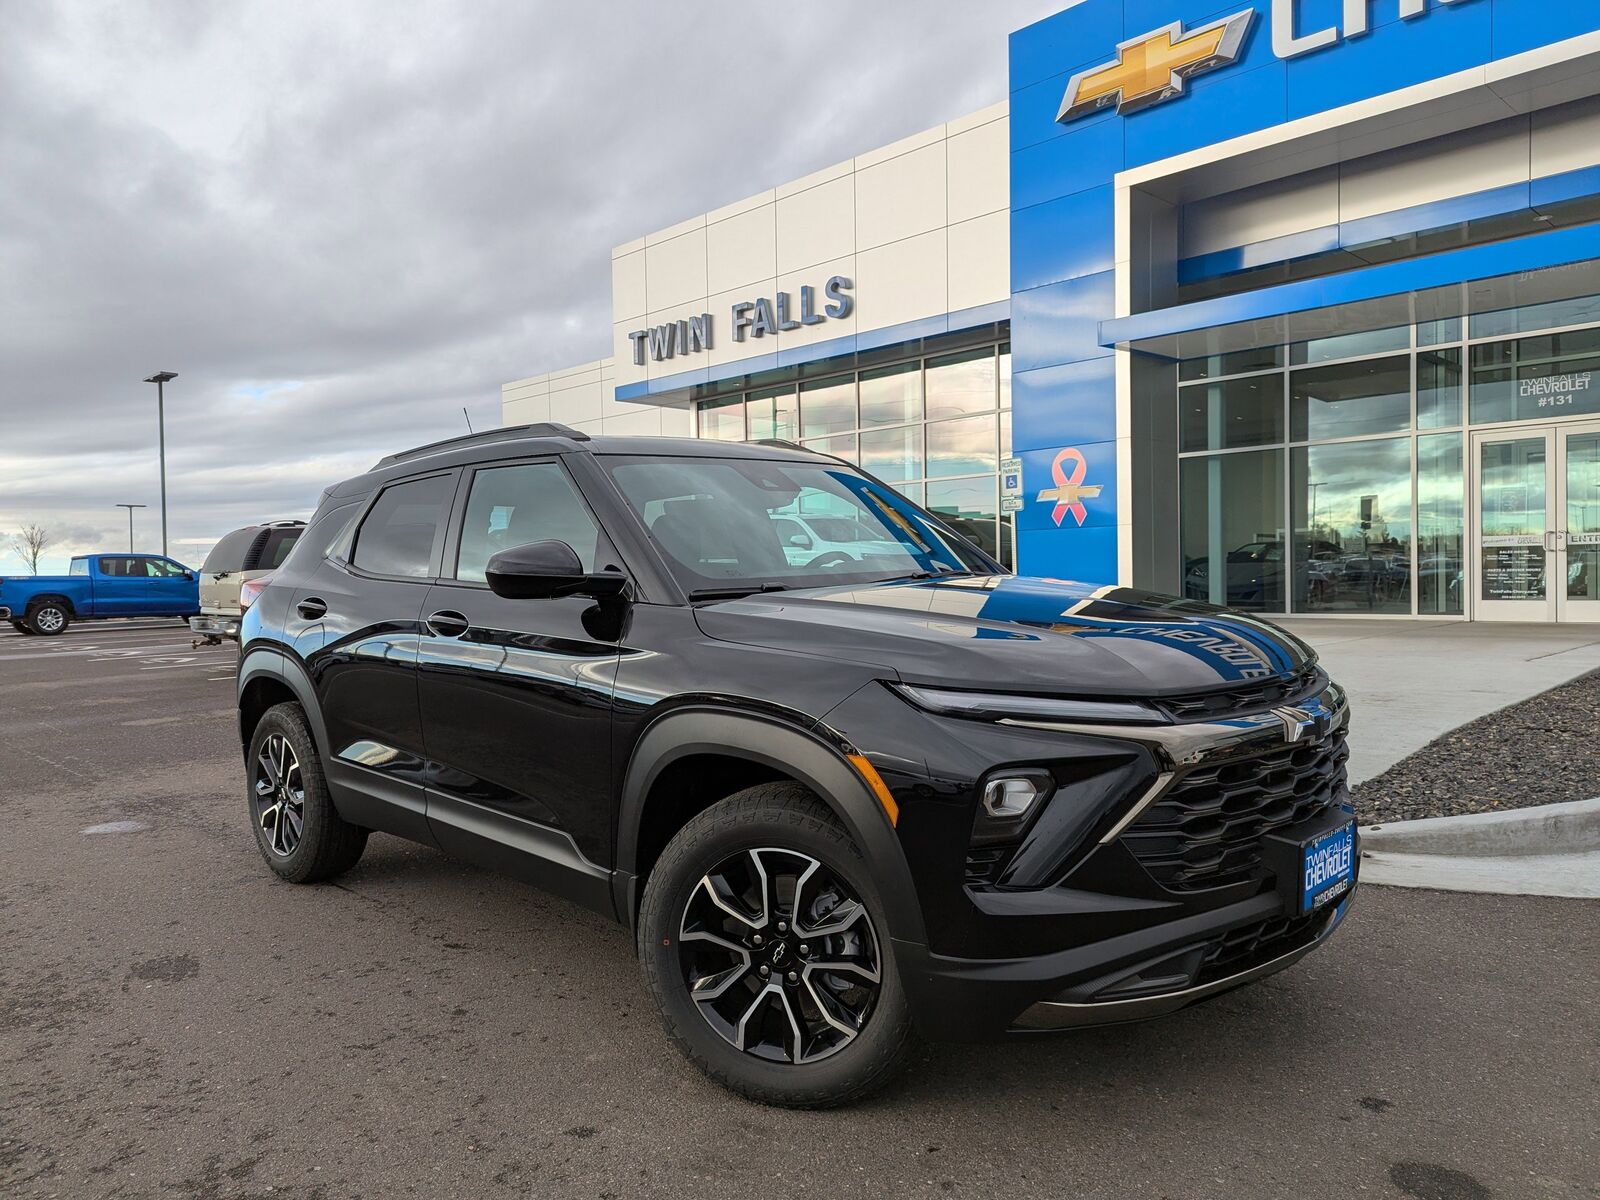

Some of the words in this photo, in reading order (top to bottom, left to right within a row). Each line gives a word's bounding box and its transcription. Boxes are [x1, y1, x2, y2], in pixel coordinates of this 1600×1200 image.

[628, 312, 713, 365] TWIN
[731, 275, 854, 342] FALLS
[1520, 378, 1590, 397] CHEVROLET
[1538, 394, 1573, 407] #131
[1305, 847, 1352, 891] CHEVROLET
[1306, 834, 1352, 869] TWINFALLS
